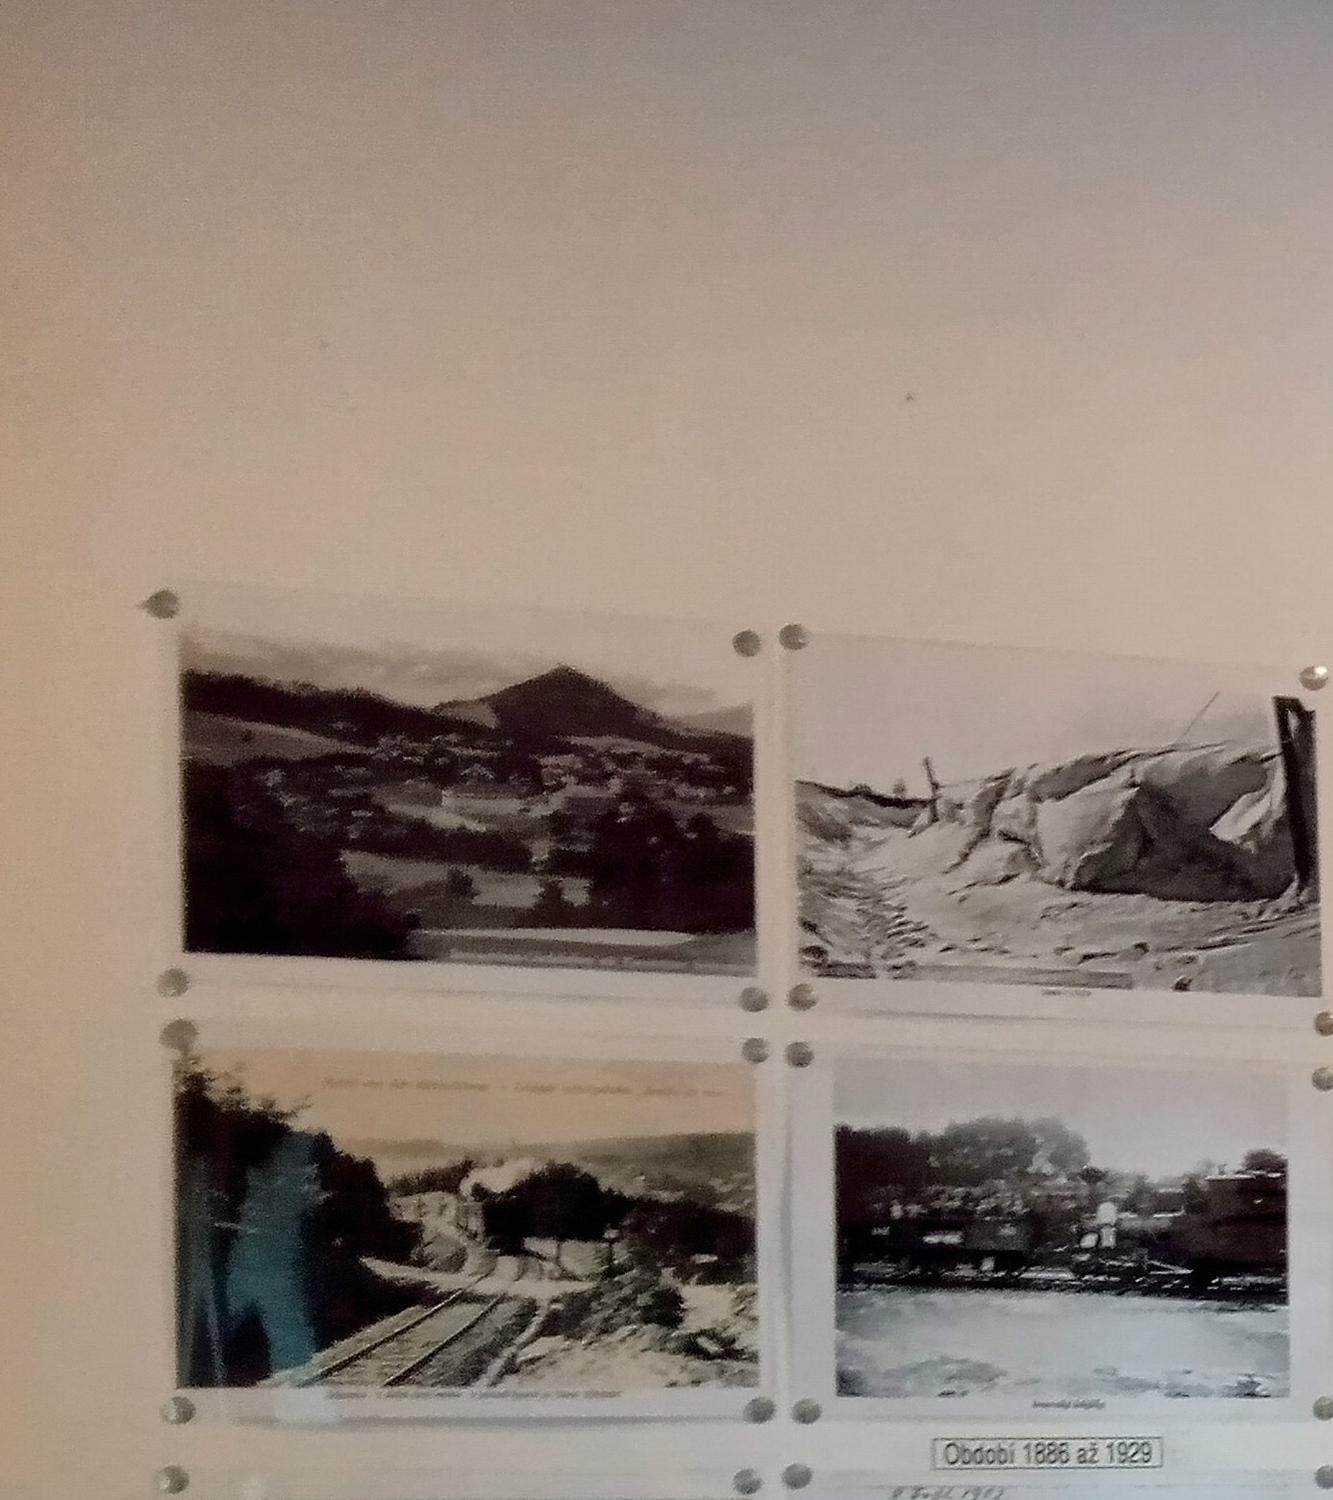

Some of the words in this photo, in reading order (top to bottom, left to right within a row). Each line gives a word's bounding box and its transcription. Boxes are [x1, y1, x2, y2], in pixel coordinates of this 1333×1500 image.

[943, 1442, 1016, 1465] Období
[1076, 1442, 1100, 1465] až
[1106, 1441, 1153, 1464] 1929
